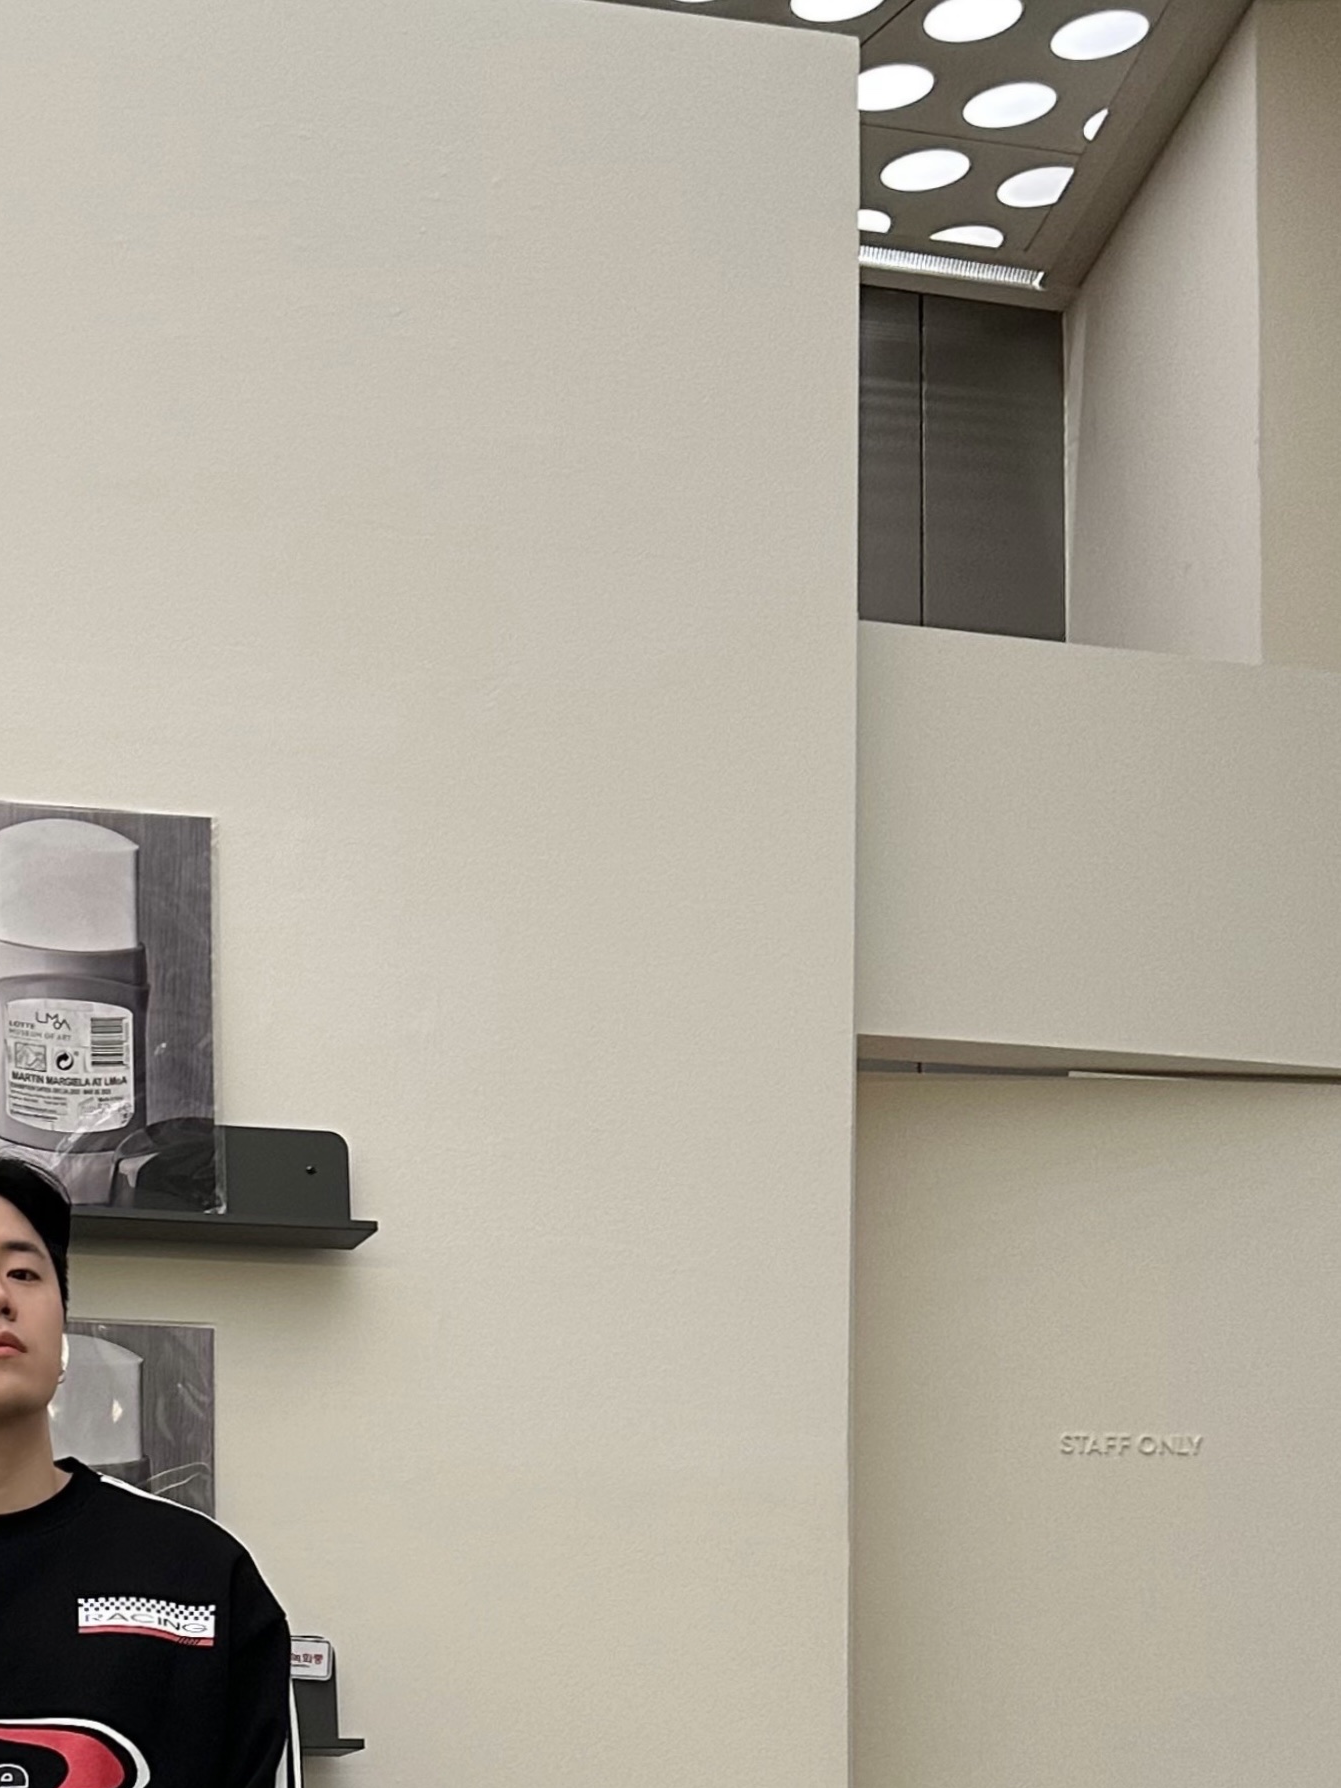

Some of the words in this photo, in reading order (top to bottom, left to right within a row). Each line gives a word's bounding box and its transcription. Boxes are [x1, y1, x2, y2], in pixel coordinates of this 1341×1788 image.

[9, 1020, 35, 1029] LOTTE
[9, 1028, 43, 1038] MUSEUM
[44, 1032, 55, 1040] OF
[57, 1033, 72, 1041] ART
[12, 1071, 44, 1084] MARTIN
[46, 1076, 91, 1087] MARGIELA
[92, 1077, 102, 1086] AT
[1060, 1434, 1132, 1456] STAFF
[1138, 1434, 1204, 1456] ONLY
[85, 1612, 207, 1633] RACING
